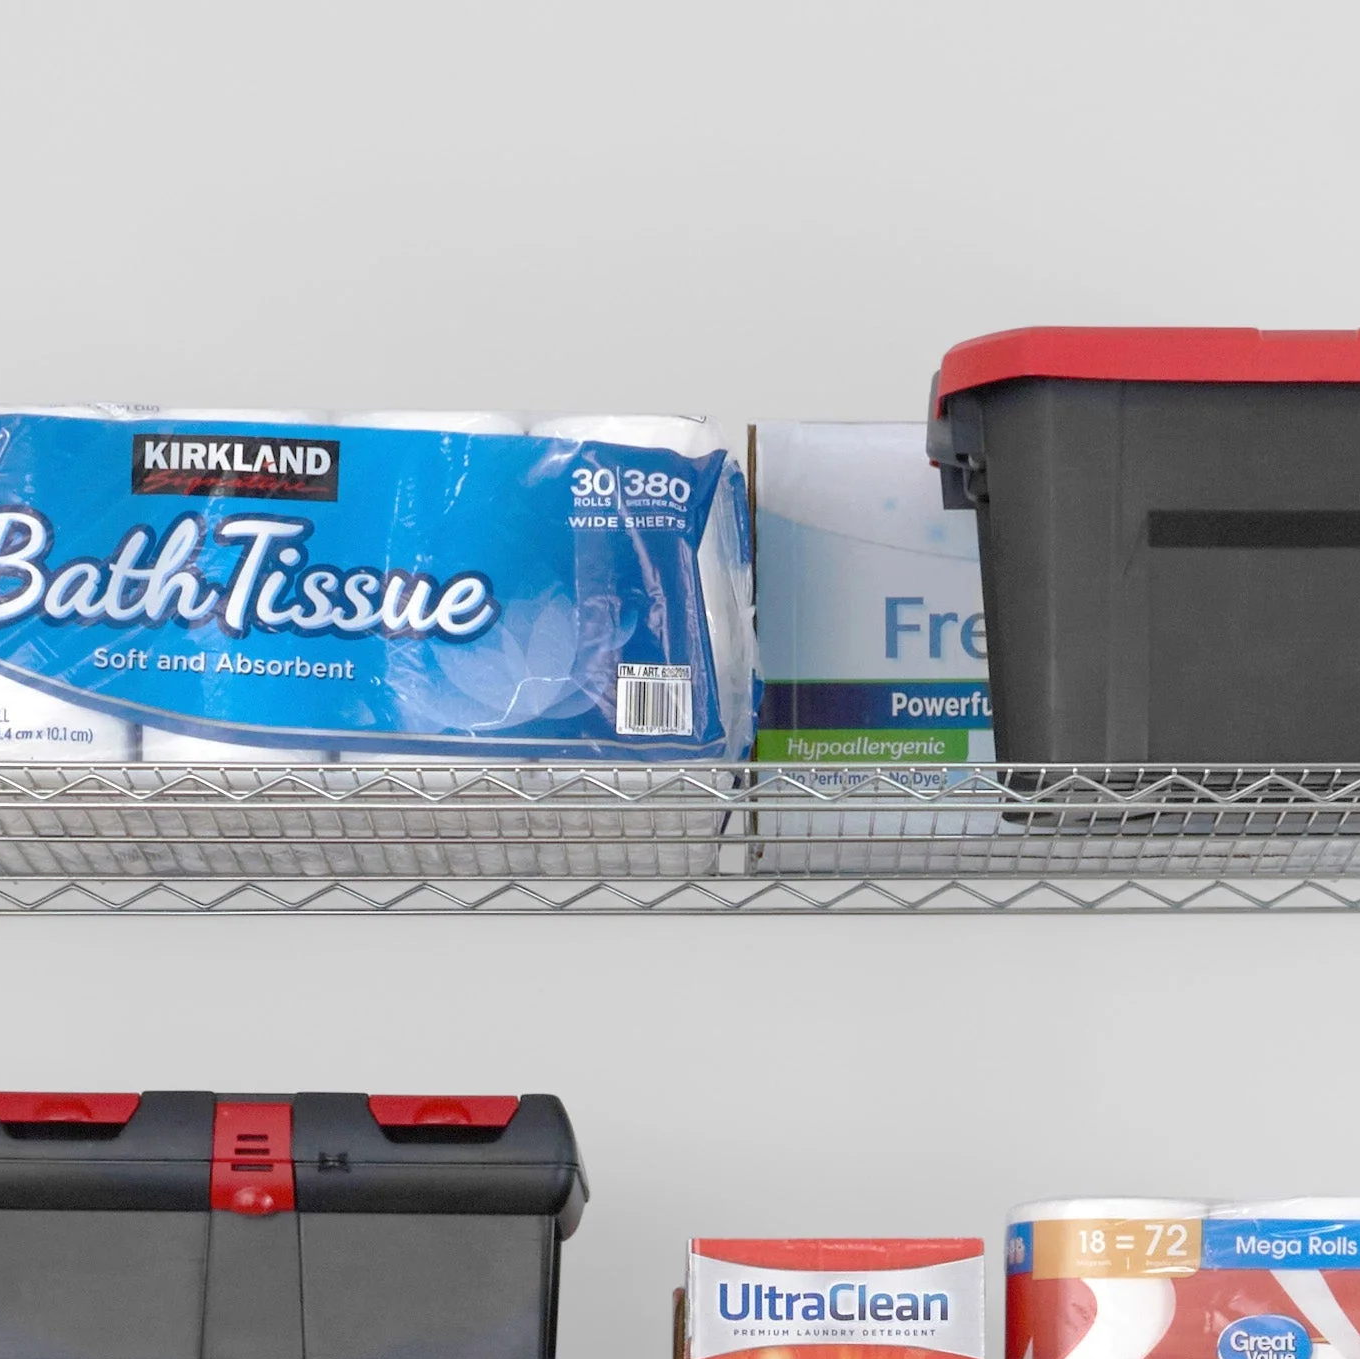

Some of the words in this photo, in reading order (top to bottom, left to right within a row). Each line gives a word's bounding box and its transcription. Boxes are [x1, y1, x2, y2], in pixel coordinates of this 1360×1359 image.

[143, 441, 332, 475] KIRKLAND
[571, 468, 615, 497] 30
[624, 470, 690, 503] 380
[574, 497, 611, 507] ROLLS
[568, 516, 618, 528] WIDE
[624, 516, 686, 530] SHEETS
[222, 519, 492, 635] Tissue
[885, 597, 987, 660] Fre
[94, 648, 147, 671] Soft
[158, 652, 205, 673] and
[216, 652, 355, 680] Absorbent
[891, 692, 993, 718] Powerfu
[787, 737, 945, 761] Hypoallergenic
[1078, 1230, 1105, 1254] 18
[1145, 1225, 1188, 1257] 72
[1236, 1236, 1301, 1260] Mega
[1309, 1236, 1357, 1256] Rolls
[719, 1283, 949, 1321] UltraClean
[1230, 1330, 1296, 1354] Great
